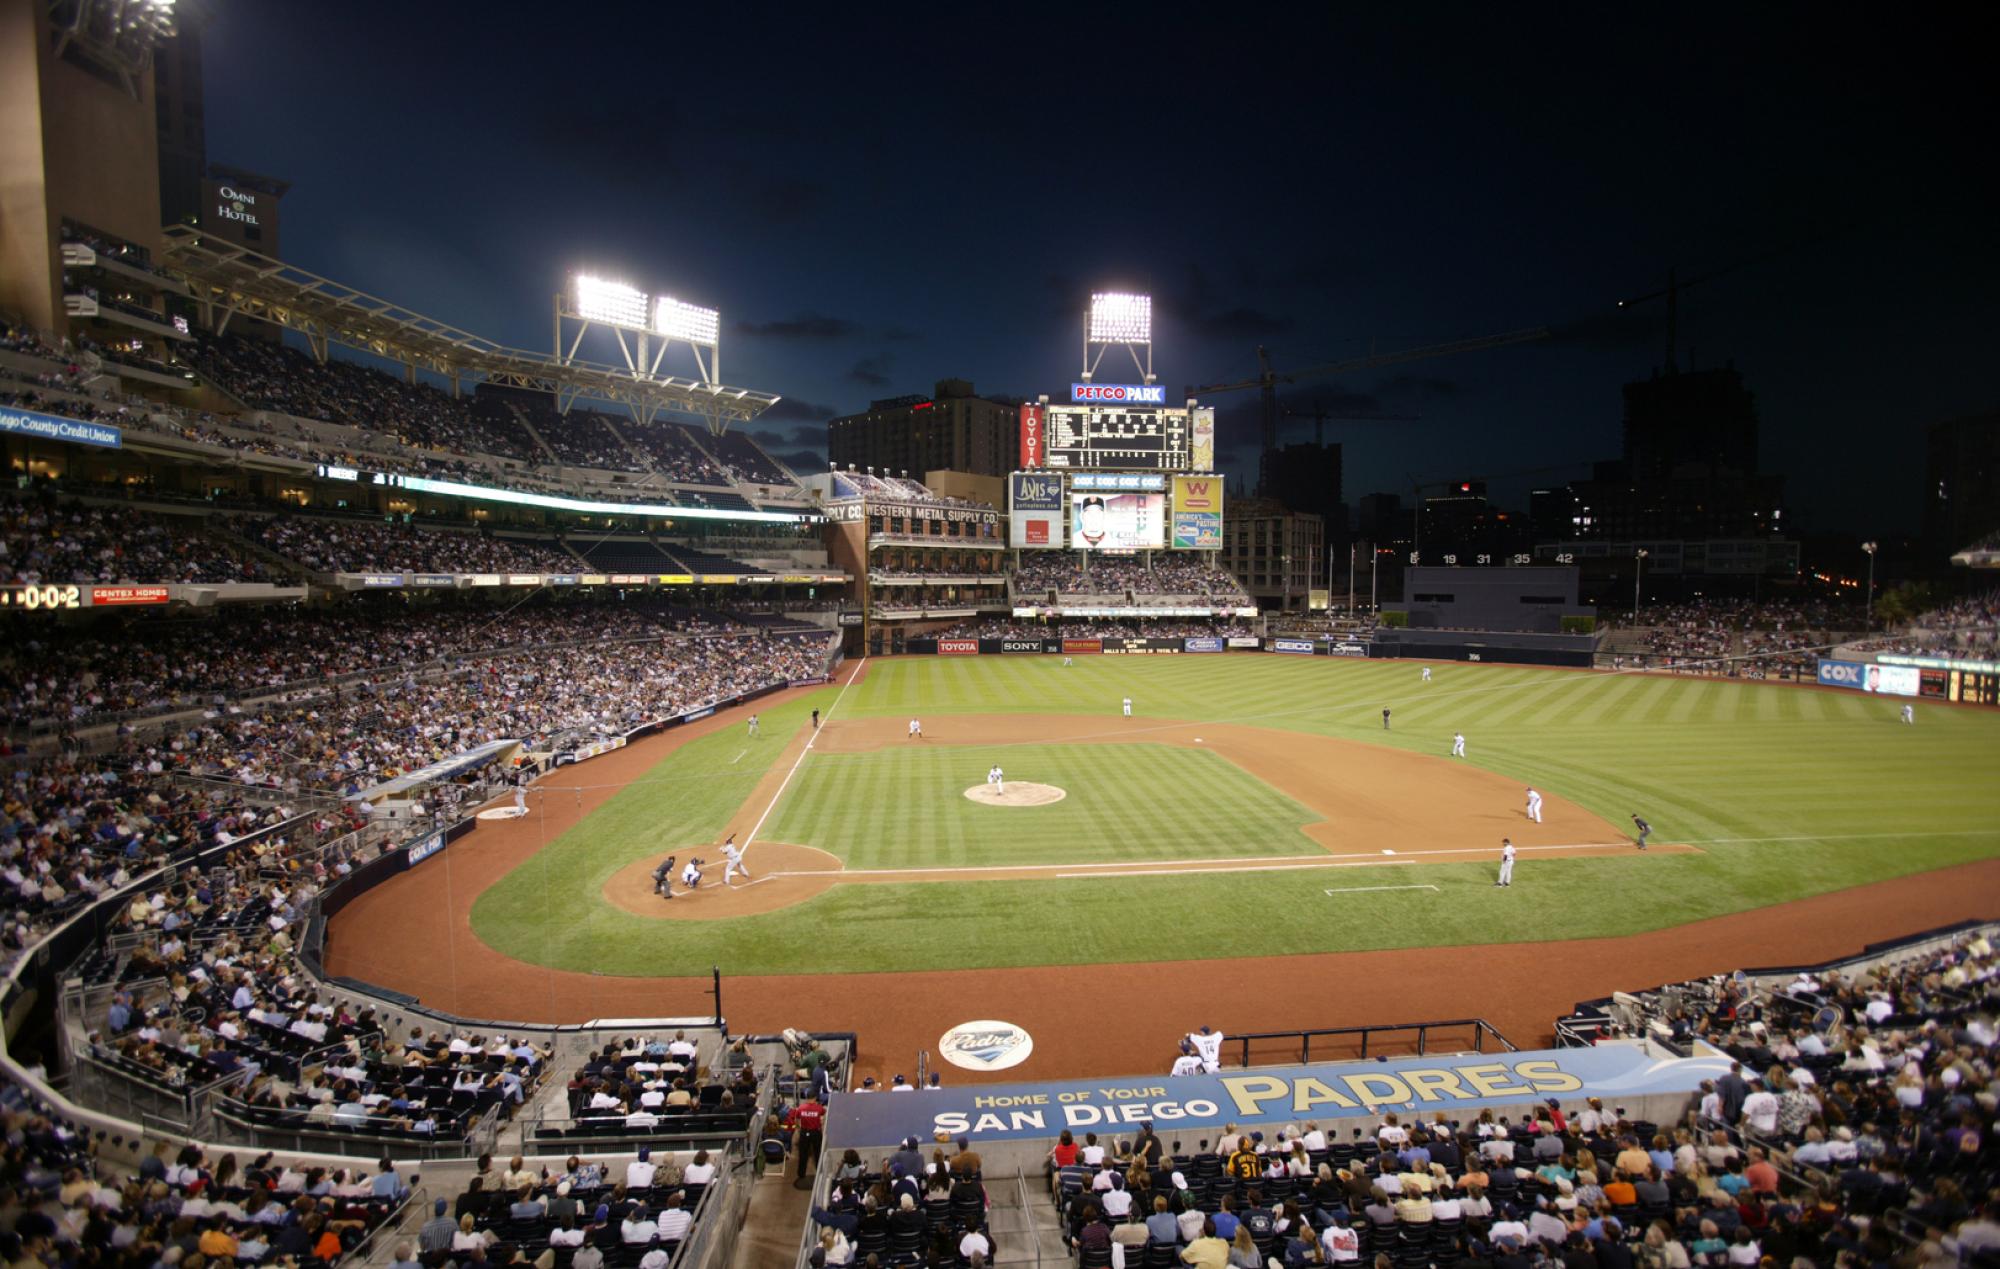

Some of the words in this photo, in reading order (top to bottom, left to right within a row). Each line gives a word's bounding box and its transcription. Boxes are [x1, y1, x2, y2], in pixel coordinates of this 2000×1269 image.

[220, 186, 255, 205] OMNI
[218, 206, 259, 225] HOTEL
[1076, 386, 1126, 400] PETCO
[1126, 387, 1162, 401] PARK
[20, 416, 59, 436] County
[59, 423, 89, 438] Credit
[89, 428, 116, 443] Union
[1026, 407, 1038, 467] TOYOTA
[866, 504, 912, 518] WESTERN
[916, 507, 946, 521] METAL
[948, 510, 980, 523] SUPPLY
[983, 513, 997, 524] CO.
[1443, 555, 1456, 564] 19
[1477, 554, 1491, 564] 31
[1514, 554, 1530, 564] 35
[1555, 554, 1573, 564] 42
[66, 585, 79, 607] 2
[94, 590, 133, 598] CENTEX
[136, 589, 168, 597] HOMES
[941, 642, 976, 651] TOYOTA
[1277, 641, 1312, 650] GEICO
[1821, 664, 1858, 681] COX
[1205, 1045, 1214, 1054] 14
[1220, 1060, 1583, 1117] PADRES
[975, 1094, 1049, 1108] HOME
[1057, 1091, 1091, 1103] OF
[1099, 1087, 1167, 1100] YOUR
[932, 1110, 1046, 1136] SAN
[1061, 1099, 1219, 1127] DIEGO
[1242, 1164, 1256, 1178] 31
